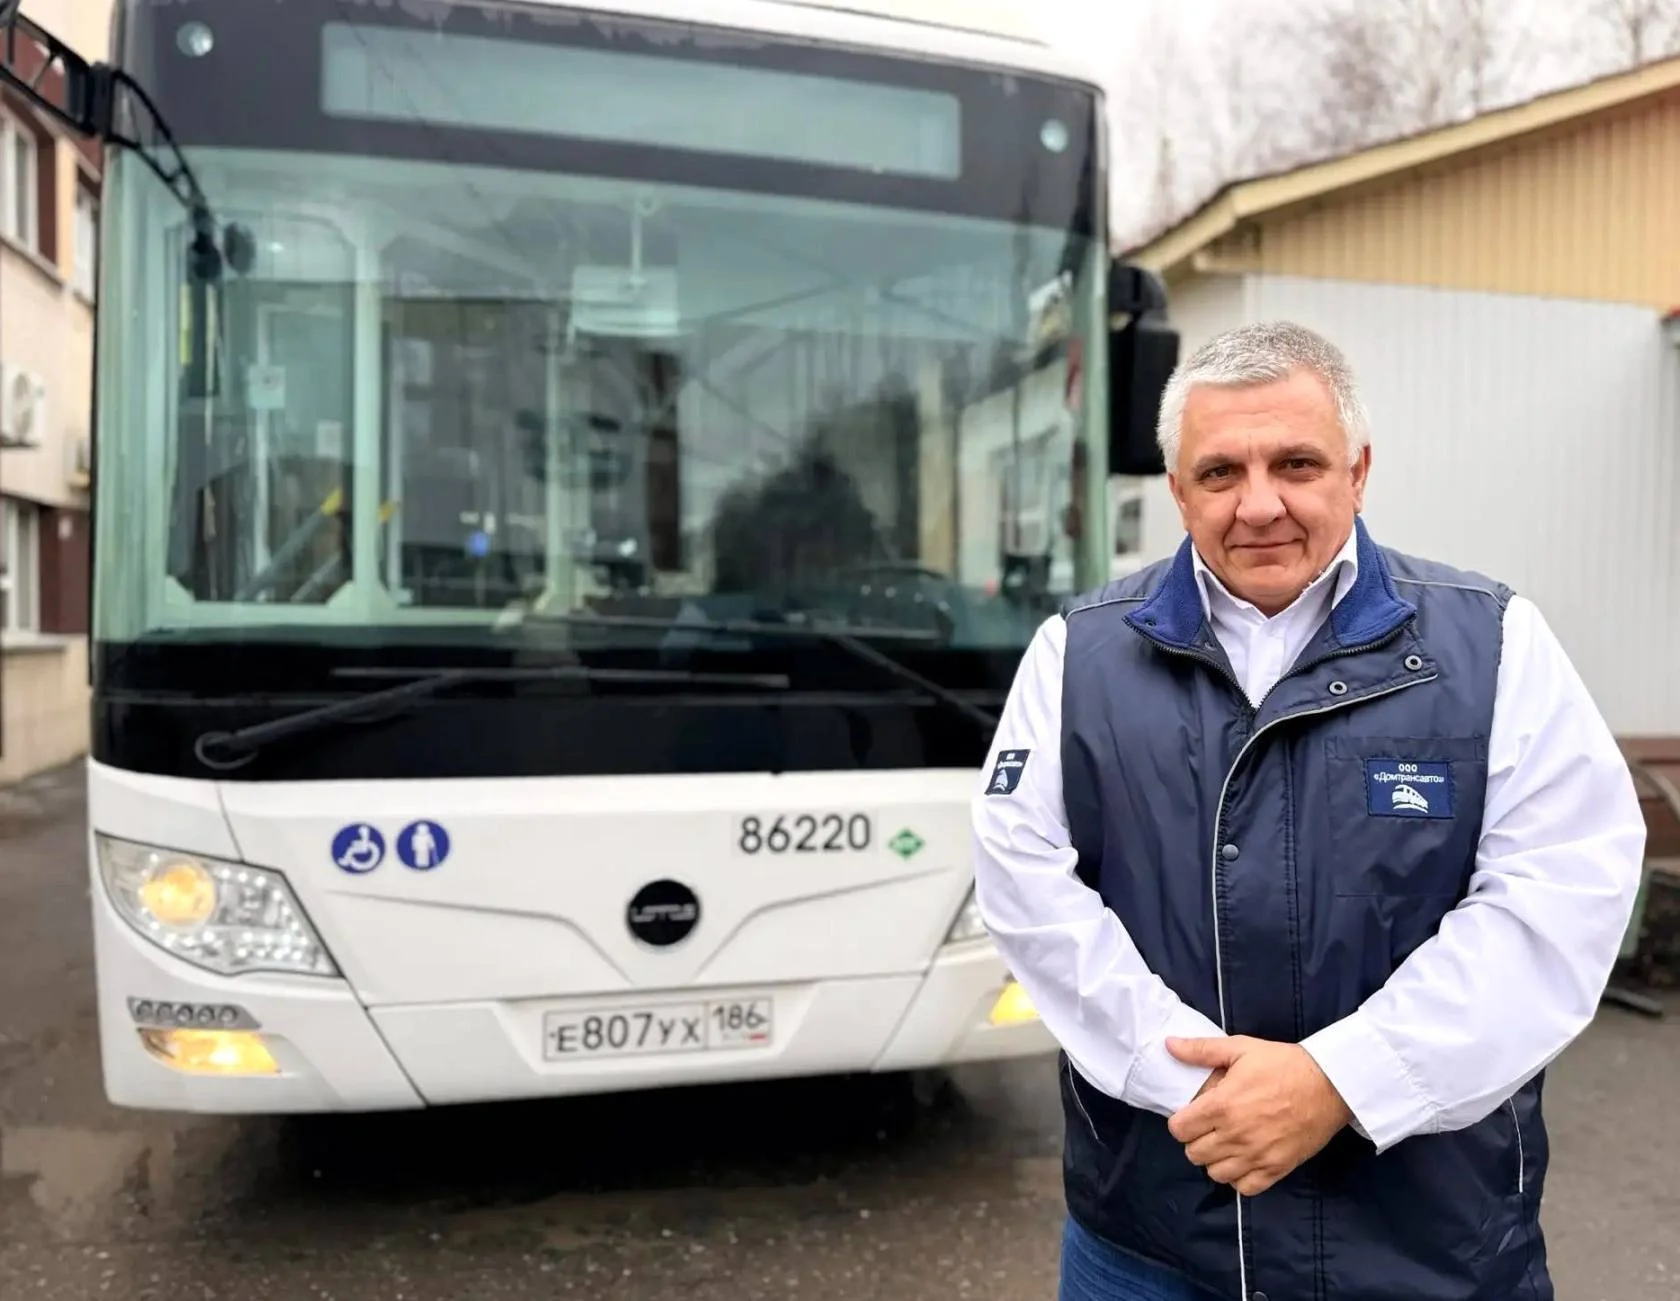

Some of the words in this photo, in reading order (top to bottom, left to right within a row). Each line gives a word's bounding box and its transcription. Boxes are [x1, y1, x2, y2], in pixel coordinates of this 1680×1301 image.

[1398, 763, 1418, 772] ООО
[739, 812, 871, 854] 86220
[712, 1001, 759, 1030] 186
